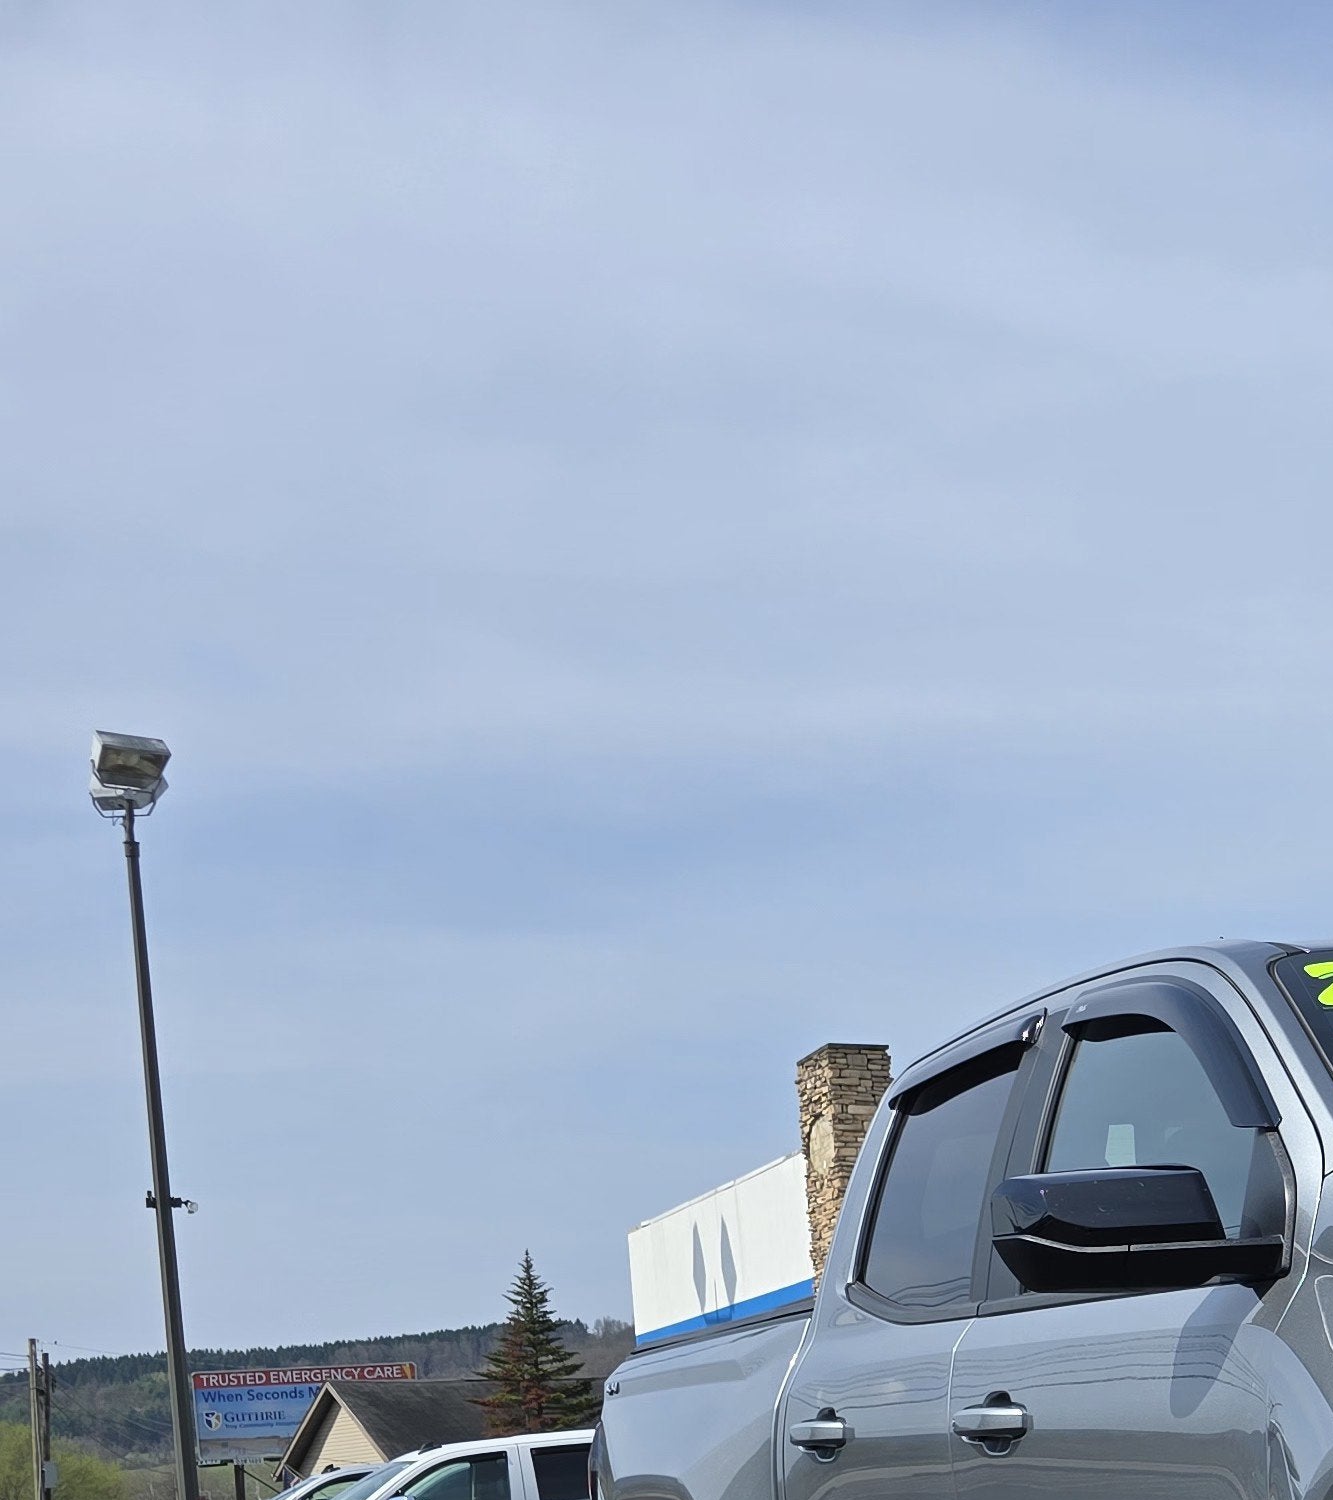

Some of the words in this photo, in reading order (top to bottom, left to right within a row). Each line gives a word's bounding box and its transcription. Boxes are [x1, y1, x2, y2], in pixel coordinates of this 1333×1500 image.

[200, 1372, 266, 1387] TRUSTED
[270, 1367, 361, 1383] EMERGENCY
[363, 1365, 402, 1379] CARE
[201, 1390, 242, 1403] When
[246, 1386, 304, 1401] Seconds
[224, 1410, 286, 1422] GUTHRIE
